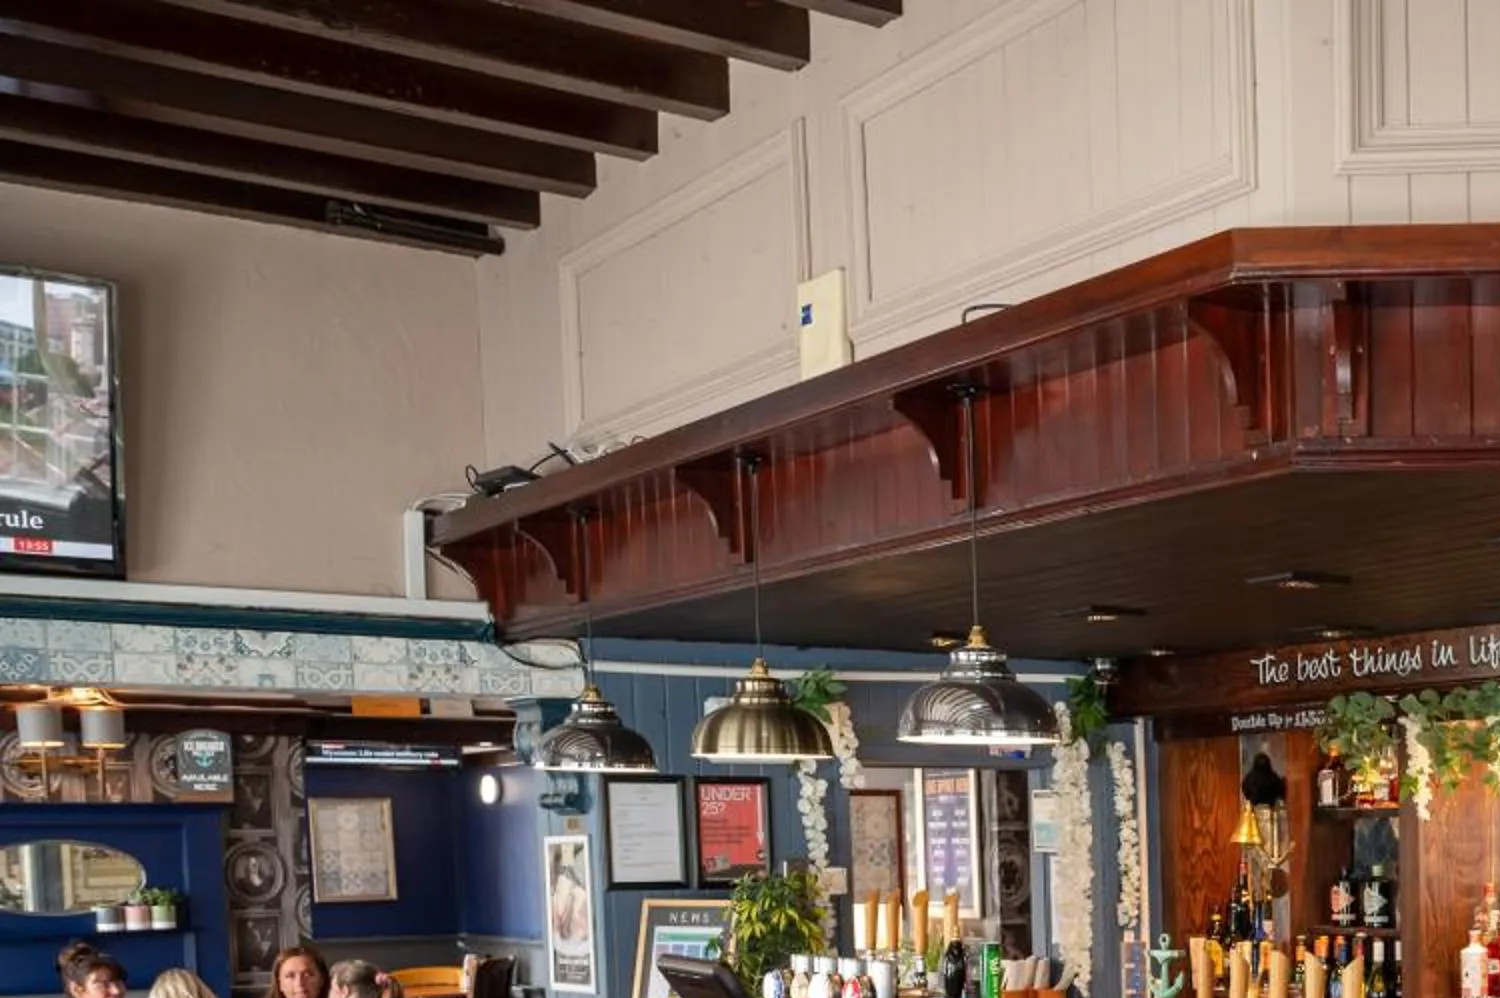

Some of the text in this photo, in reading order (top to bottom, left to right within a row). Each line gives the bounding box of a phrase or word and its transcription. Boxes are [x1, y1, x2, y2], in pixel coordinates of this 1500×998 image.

[1250, 653, 1289, 685] The
[1297, 648, 1341, 681] best
[1350, 644, 1423, 676] things
[1431, 640, 1458, 667] in
[700, 786, 751, 801] UNDER
[702, 801, 726, 815] 25?
[669, 911, 710, 924] NEWS
